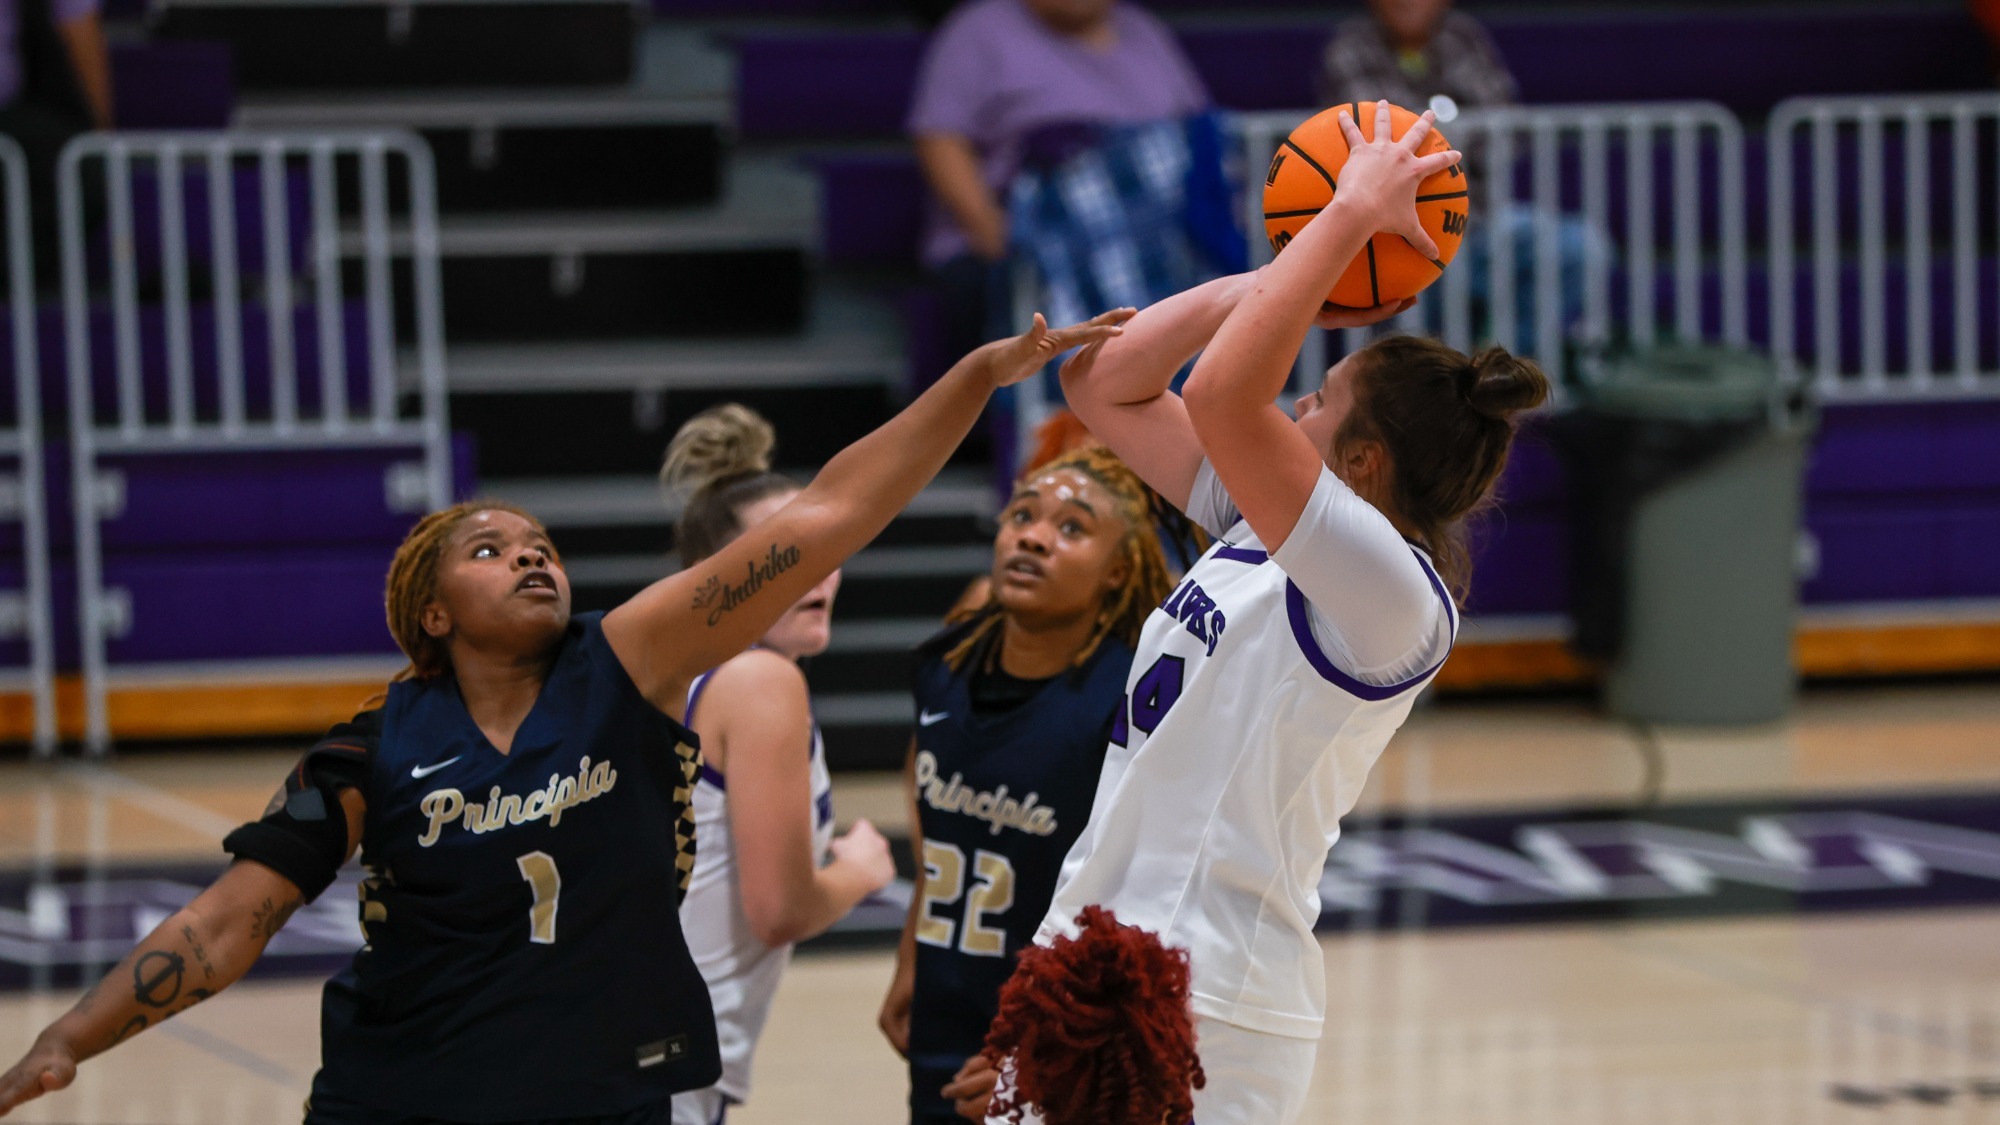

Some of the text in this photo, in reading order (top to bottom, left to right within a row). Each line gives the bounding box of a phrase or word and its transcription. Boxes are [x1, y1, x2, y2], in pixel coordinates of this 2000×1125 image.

[706, 543, 800, 628] Andrika
[418, 755, 617, 847] Principia
[516, 850, 561, 944] 1
[915, 838, 1015, 958] 22
